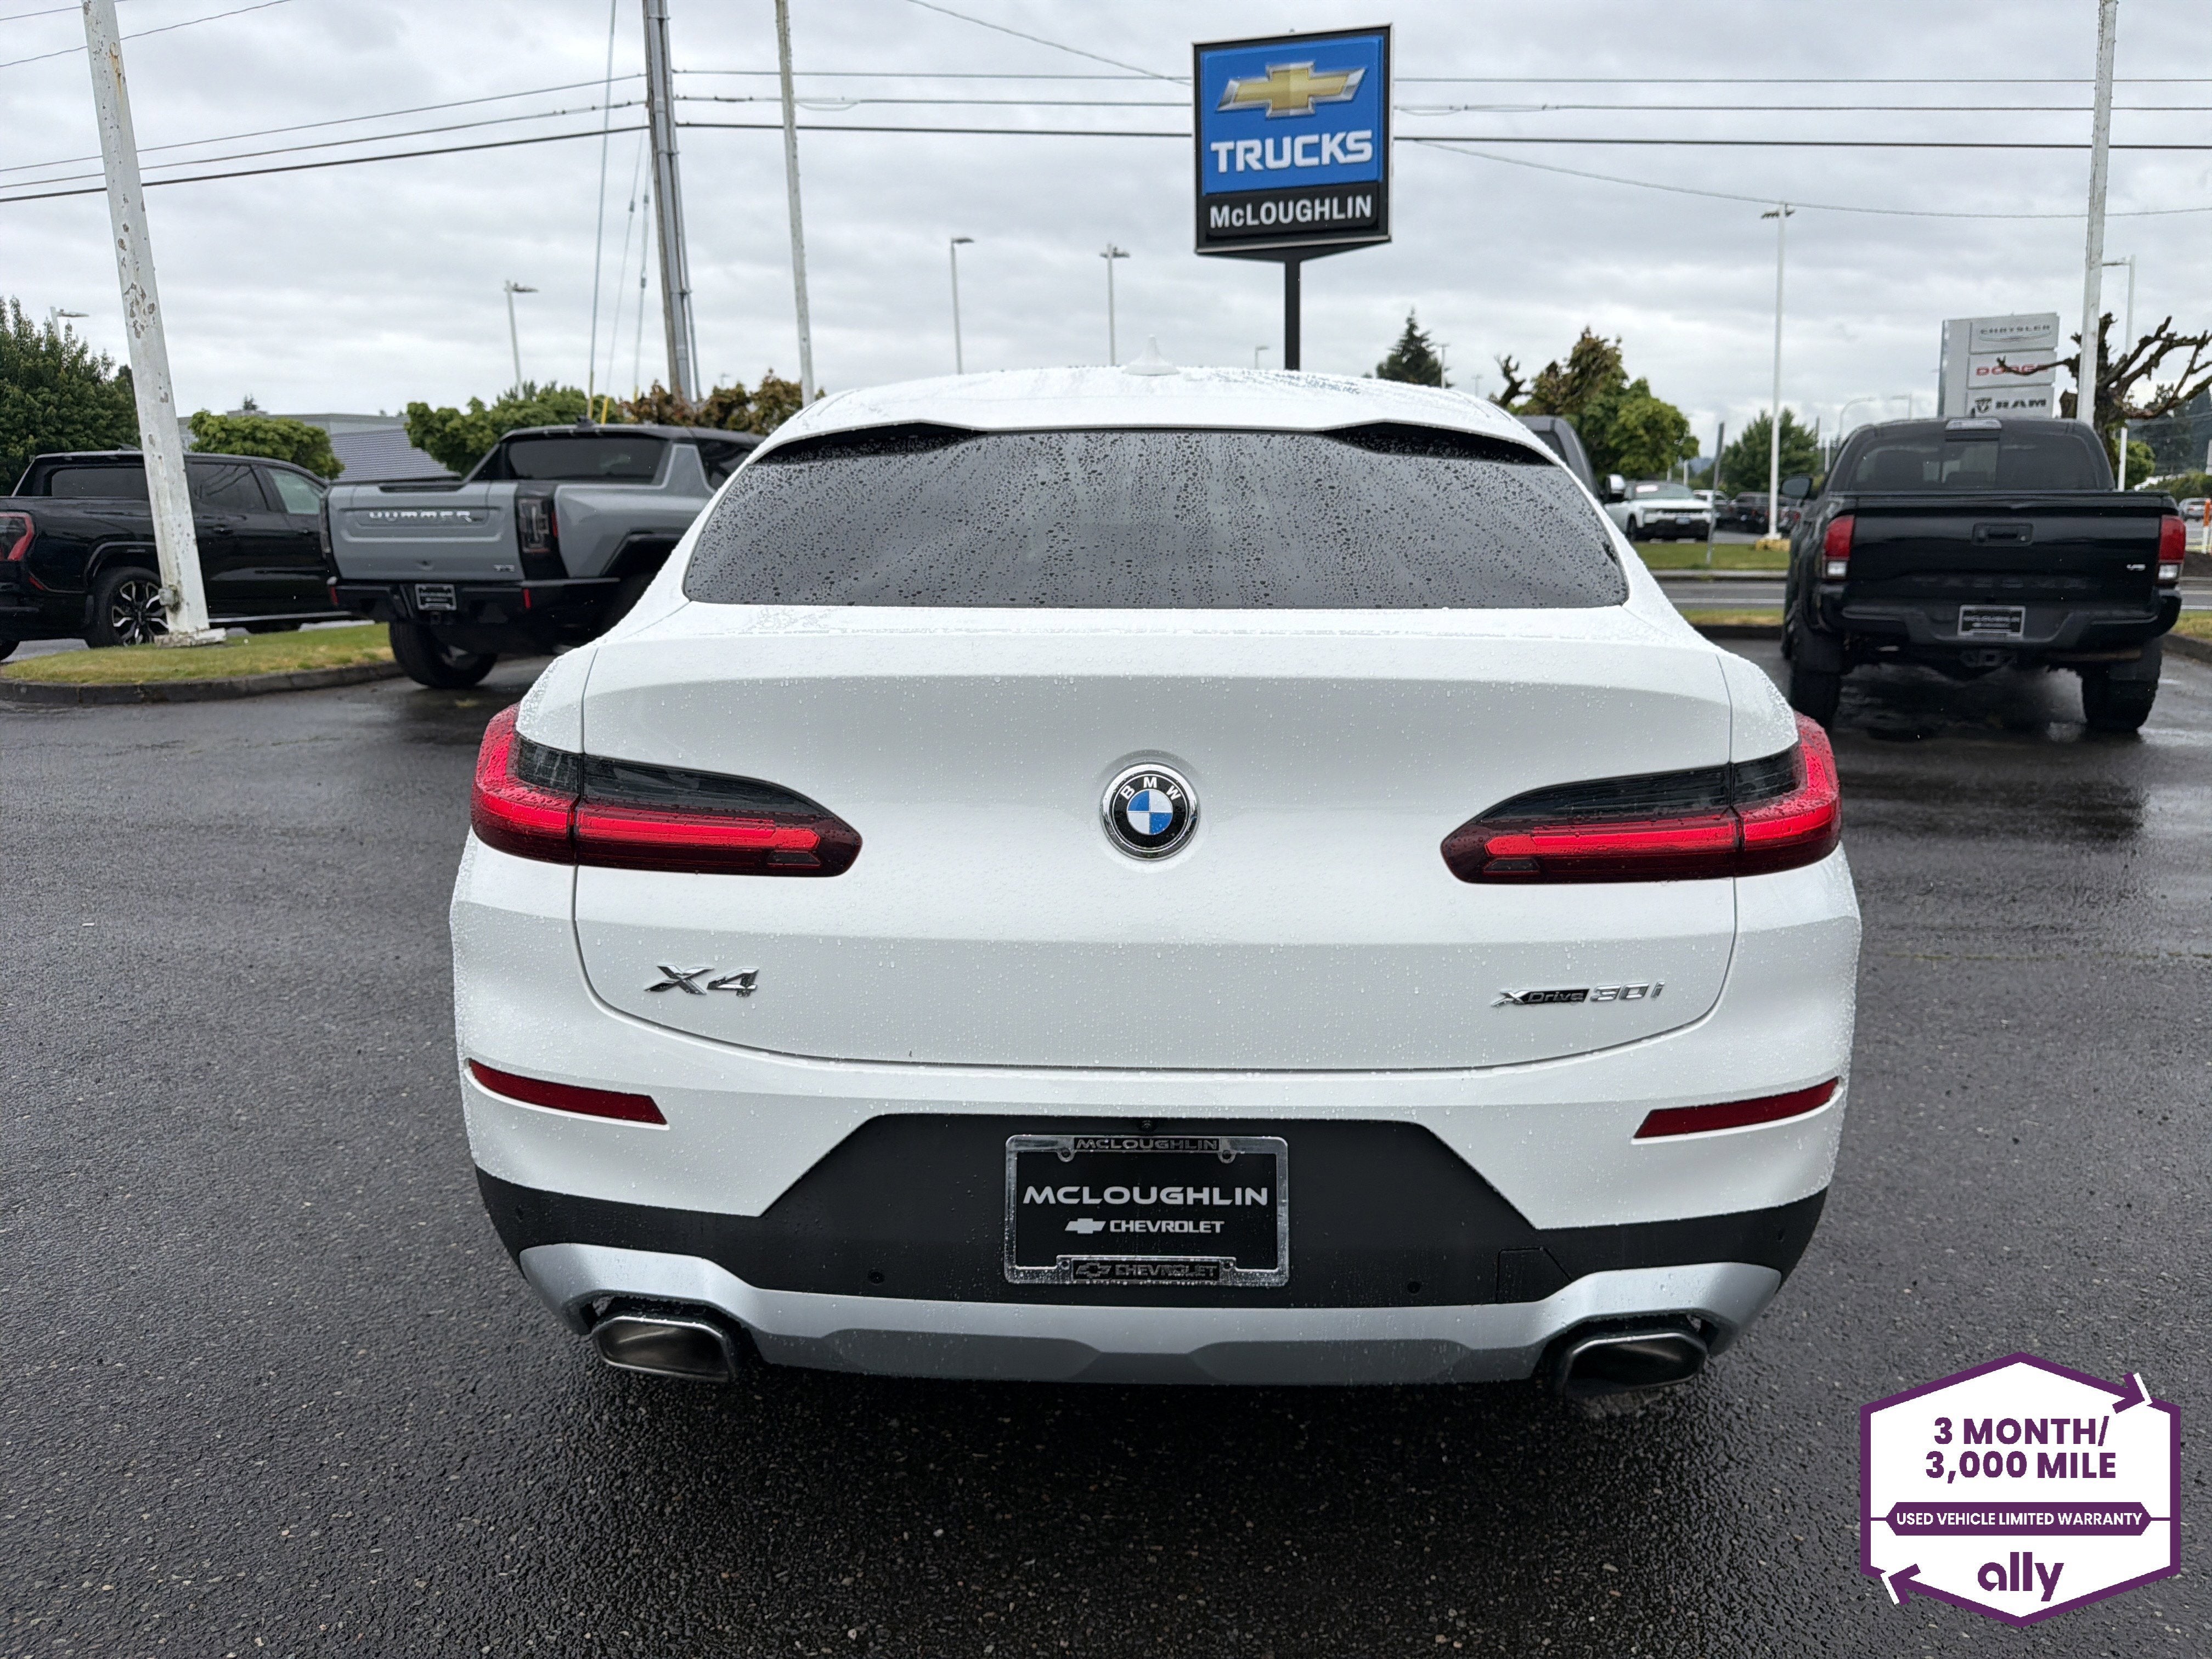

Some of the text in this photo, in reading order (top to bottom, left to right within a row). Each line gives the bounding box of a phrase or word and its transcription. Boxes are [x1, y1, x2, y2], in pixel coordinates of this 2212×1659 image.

[1210, 129, 1373, 173] TRUCKS
[1210, 195, 1372, 229] McLOUGHLIN
[1995, 399, 2046, 409] RAM
[1120, 777, 1181, 800] BMW
[644, 964, 759, 997] X4
[1076, 1138, 1217, 1150] MCLOUGHLIN
[1023, 1186, 1268, 1206] MCLOUGHLIN
[1110, 1220, 1224, 1233] CHEVROLET
[1115, 1264, 1217, 1277] CHEVROLET
